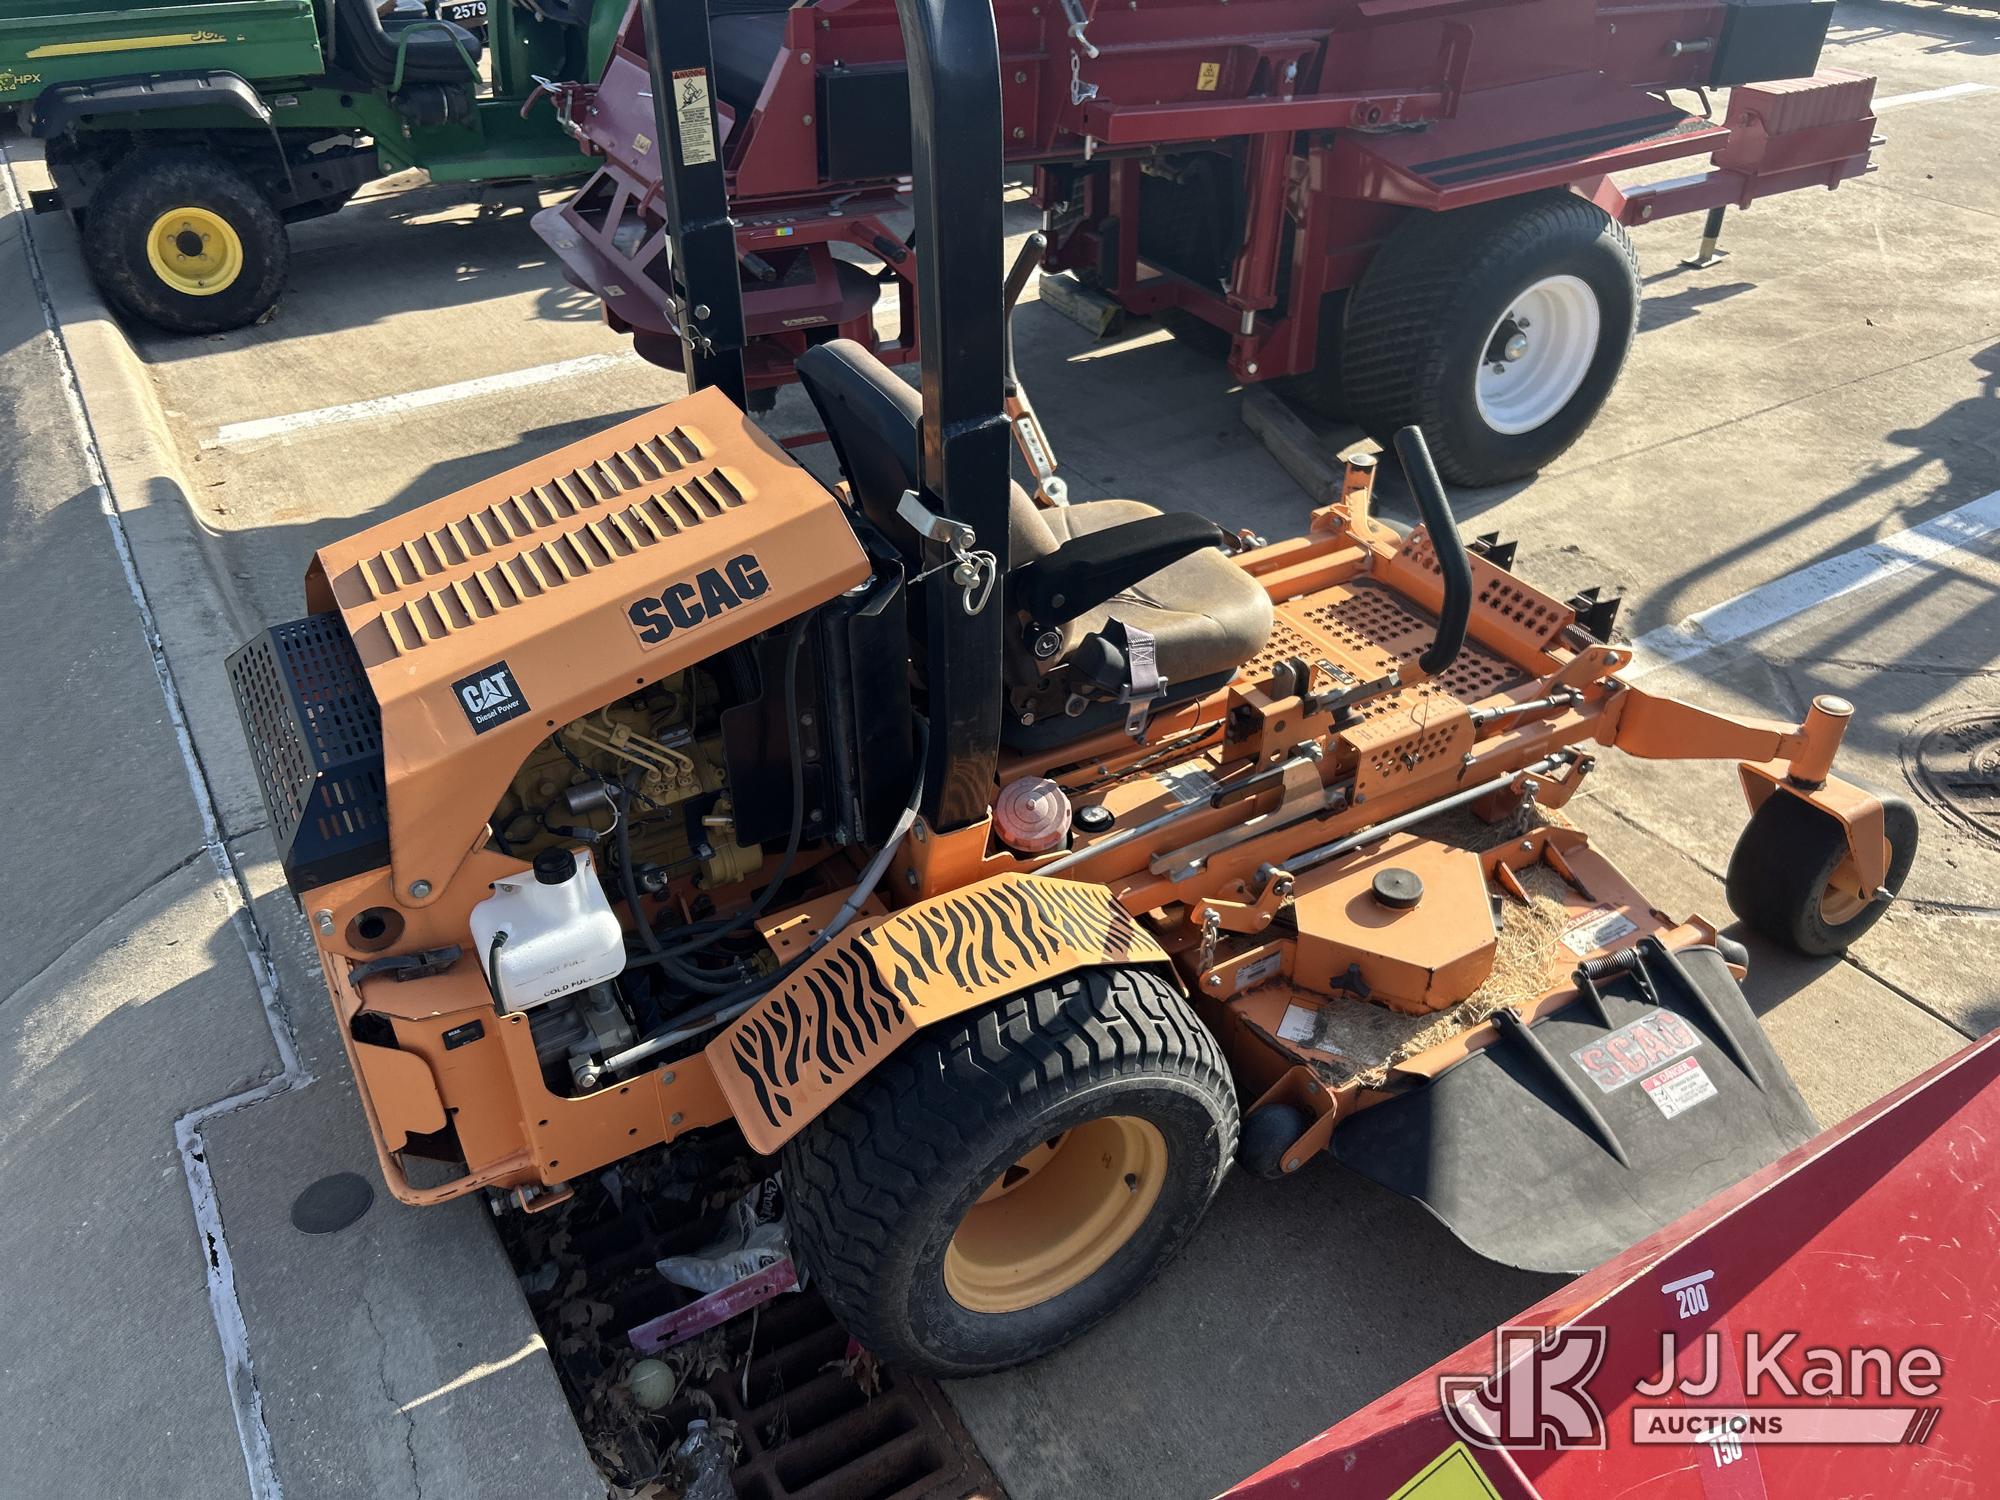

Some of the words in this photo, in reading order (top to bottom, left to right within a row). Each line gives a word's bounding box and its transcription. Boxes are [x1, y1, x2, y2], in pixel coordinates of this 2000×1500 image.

[452, 2, 487, 19] 2579
[14, 73, 41, 84] HPX
[628, 553, 769, 643] SCAG
[462, 671, 513, 713] CAT
[475, 708, 498, 724] Diesel
[497, 700, 520, 713] Power
[543, 984, 569, 997] COLD
[1582, 1011, 1694, 1085] SCAG
[1659, 1061, 1690, 1083] DANGER
[1676, 1283, 1709, 1319] 200
[1709, 1431, 1743, 1468] 150
